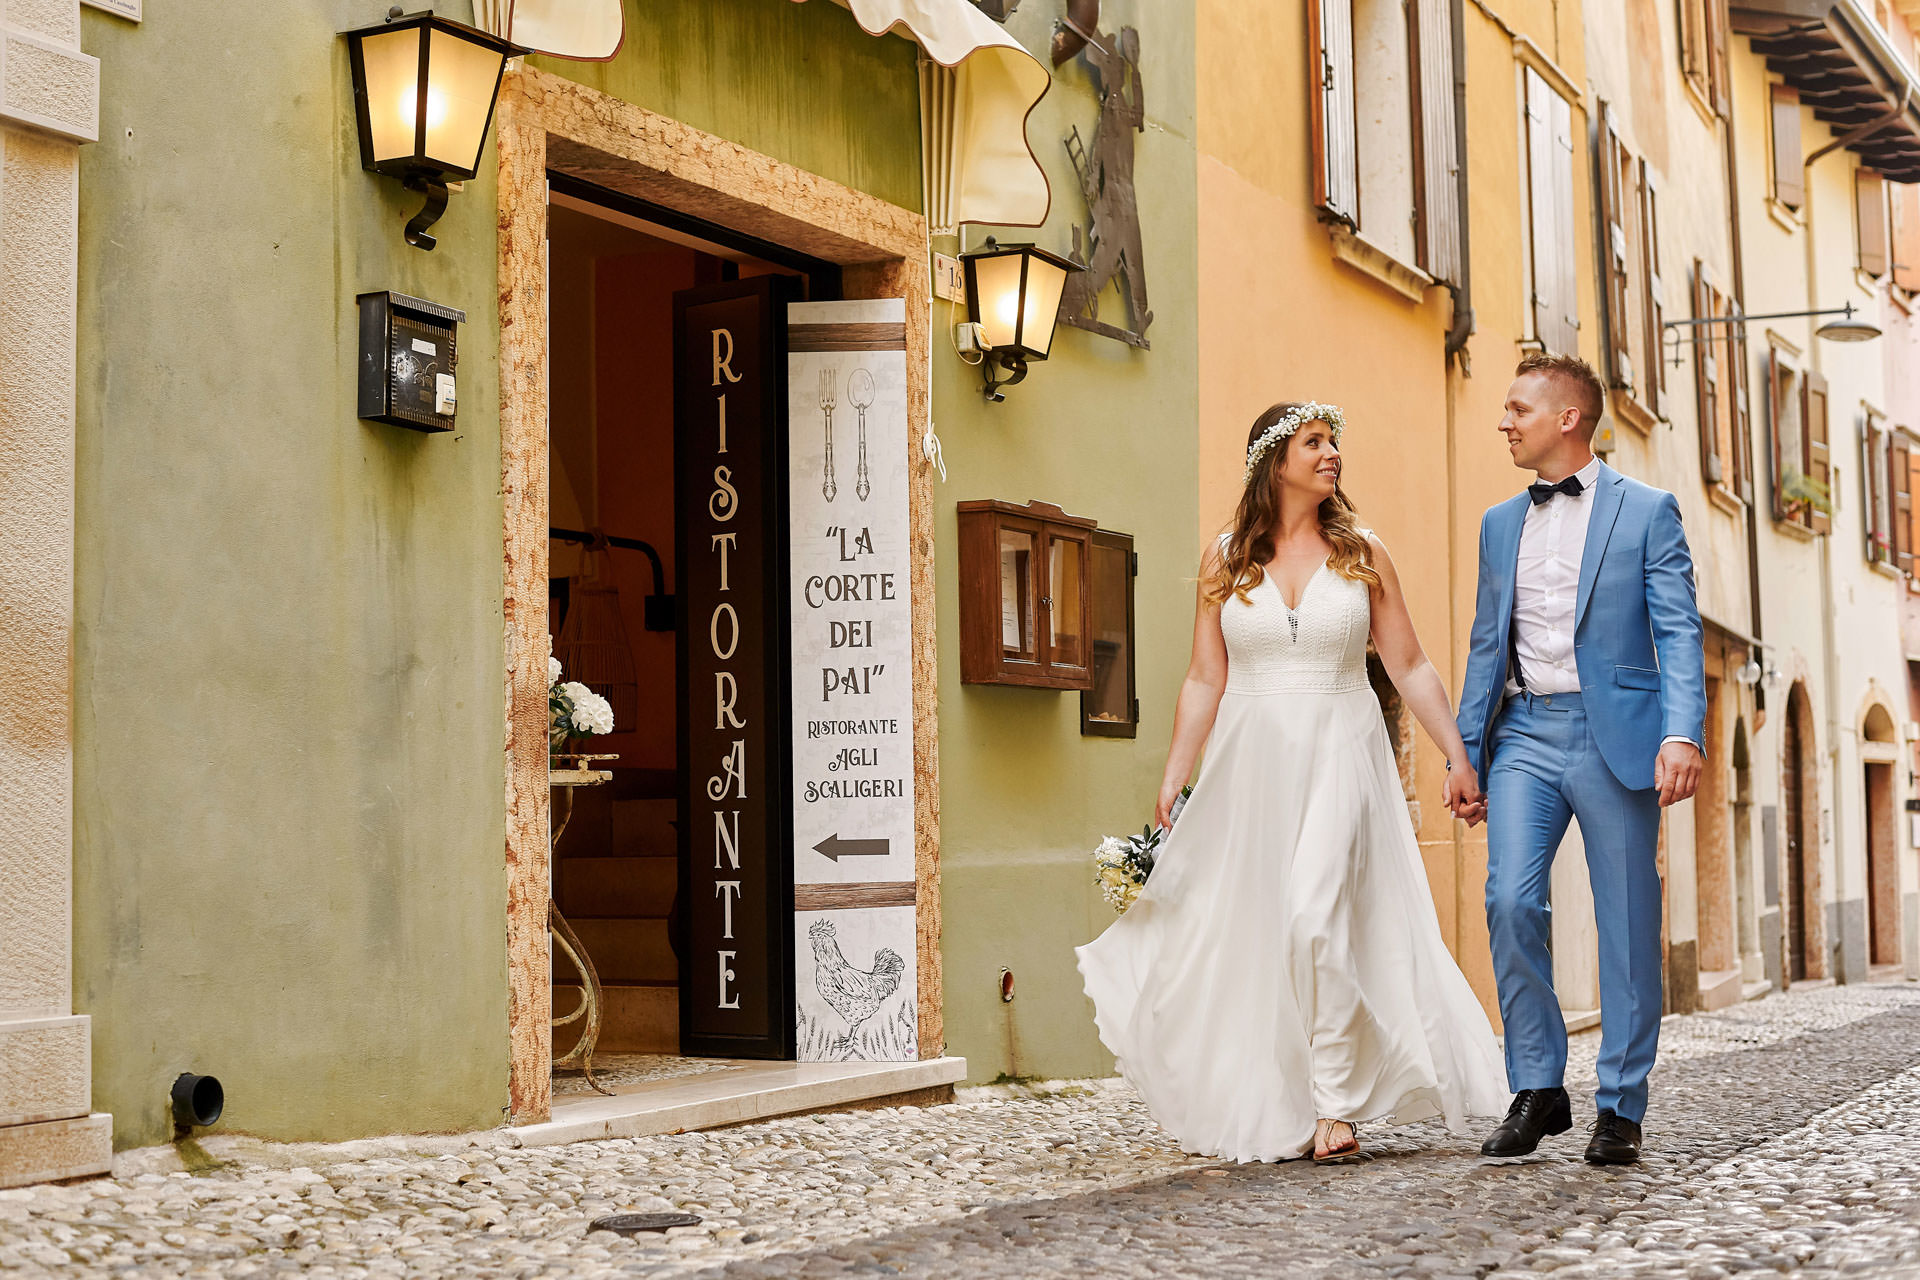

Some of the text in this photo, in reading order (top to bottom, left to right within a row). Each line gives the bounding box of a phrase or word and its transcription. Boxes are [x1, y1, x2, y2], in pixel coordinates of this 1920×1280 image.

[804, 573, 896, 609] CORTE
[829, 620, 873, 649] DEI
[706, 327, 747, 1009] RISTORANTE
[807, 719, 898, 739] RISTORANTE
[828, 748, 878, 772] AGLI
[803, 779, 903, 803] SCALIGERI
